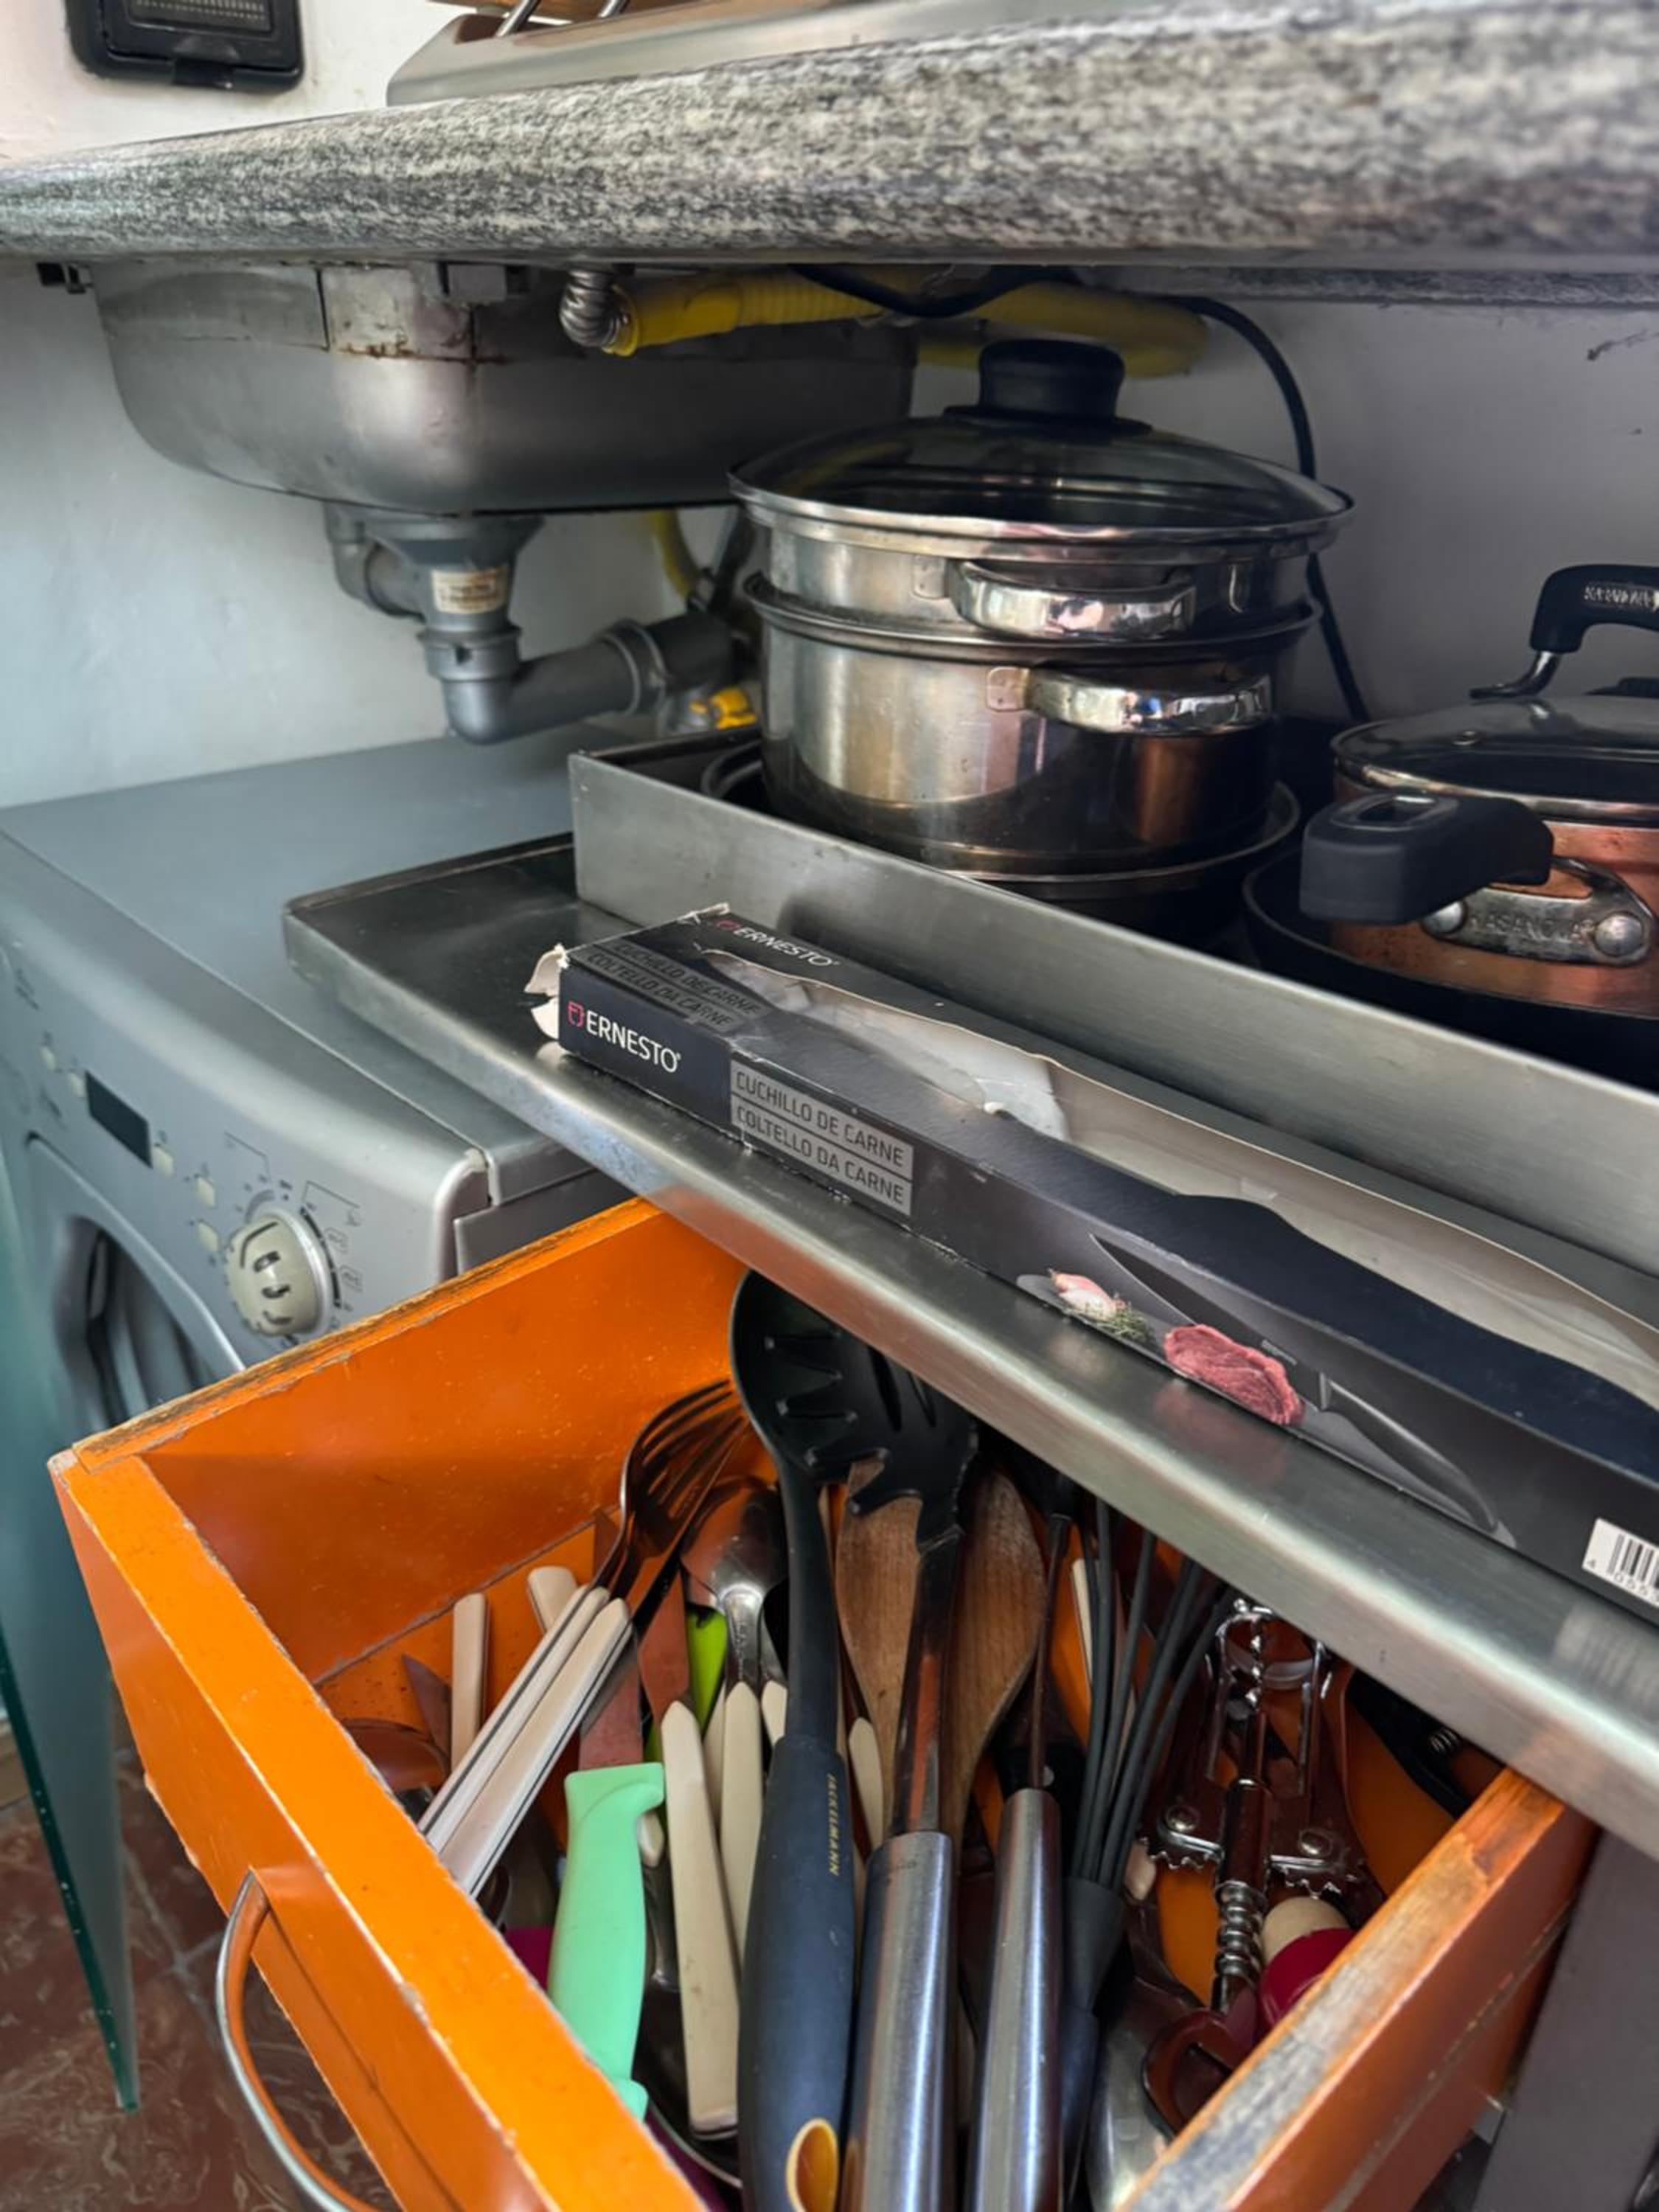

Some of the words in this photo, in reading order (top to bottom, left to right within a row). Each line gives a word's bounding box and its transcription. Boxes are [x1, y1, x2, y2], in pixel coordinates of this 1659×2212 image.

[734, 927, 832, 967] ERNESTO
[588, 953, 659, 990] COLTELLO
[654, 987, 680, 1002] DA
[676, 997, 732, 1025] CARNE
[681, 976, 707, 991] DE
[700, 987, 760, 1014] CARNE
[586, 1009, 678, 1073] ERNESTO
[737, 1071, 812, 1122] CUCHILLO
[816, 1110, 839, 1137] DE
[844, 1123, 903, 1168] CARNE
[737, 1106, 812, 1158] COLTELLO
[816, 1145, 840, 1173] DA
[845, 1161, 903, 1205] CARNE
